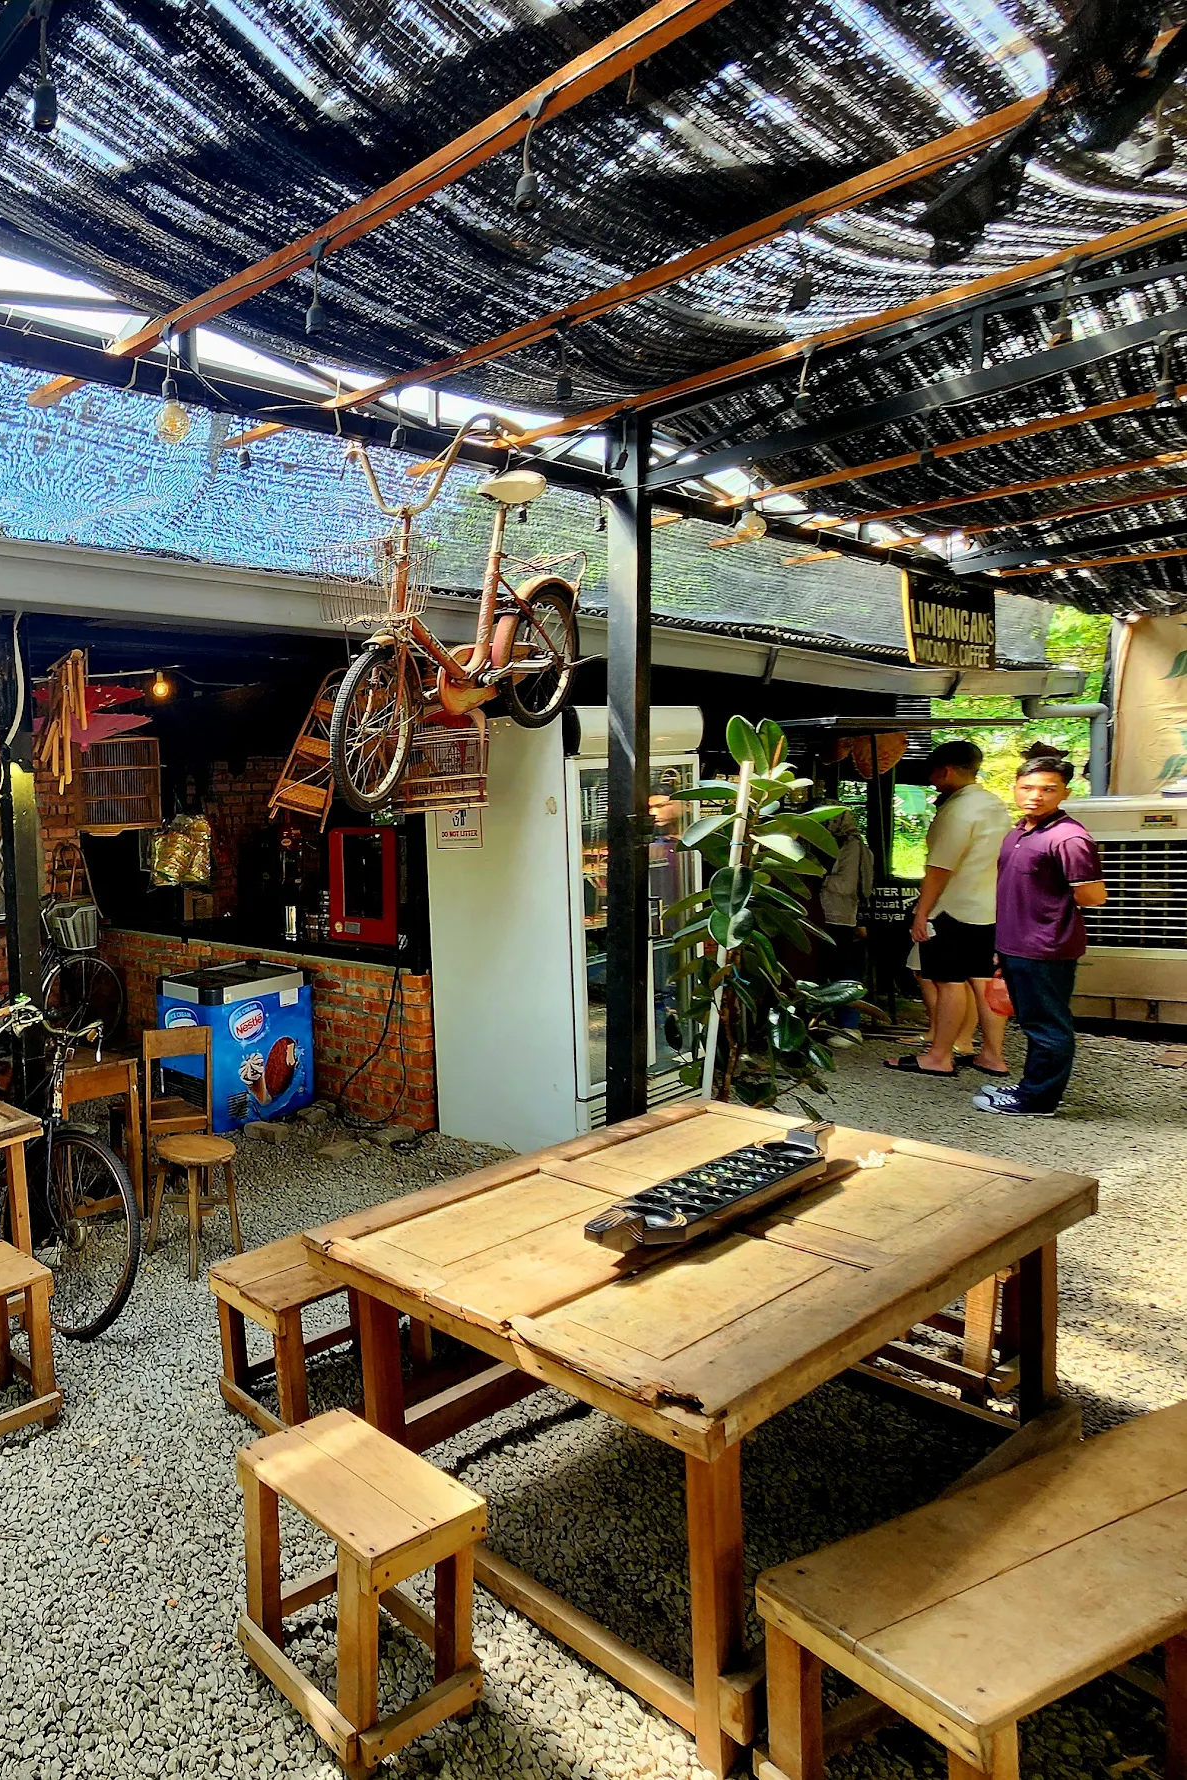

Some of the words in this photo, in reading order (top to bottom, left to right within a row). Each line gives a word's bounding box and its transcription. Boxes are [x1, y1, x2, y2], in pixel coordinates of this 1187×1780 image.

[958, 644, 990, 668] COFFEE
[875, 900, 900, 909] buat
[874, 912, 906, 923] bayar
